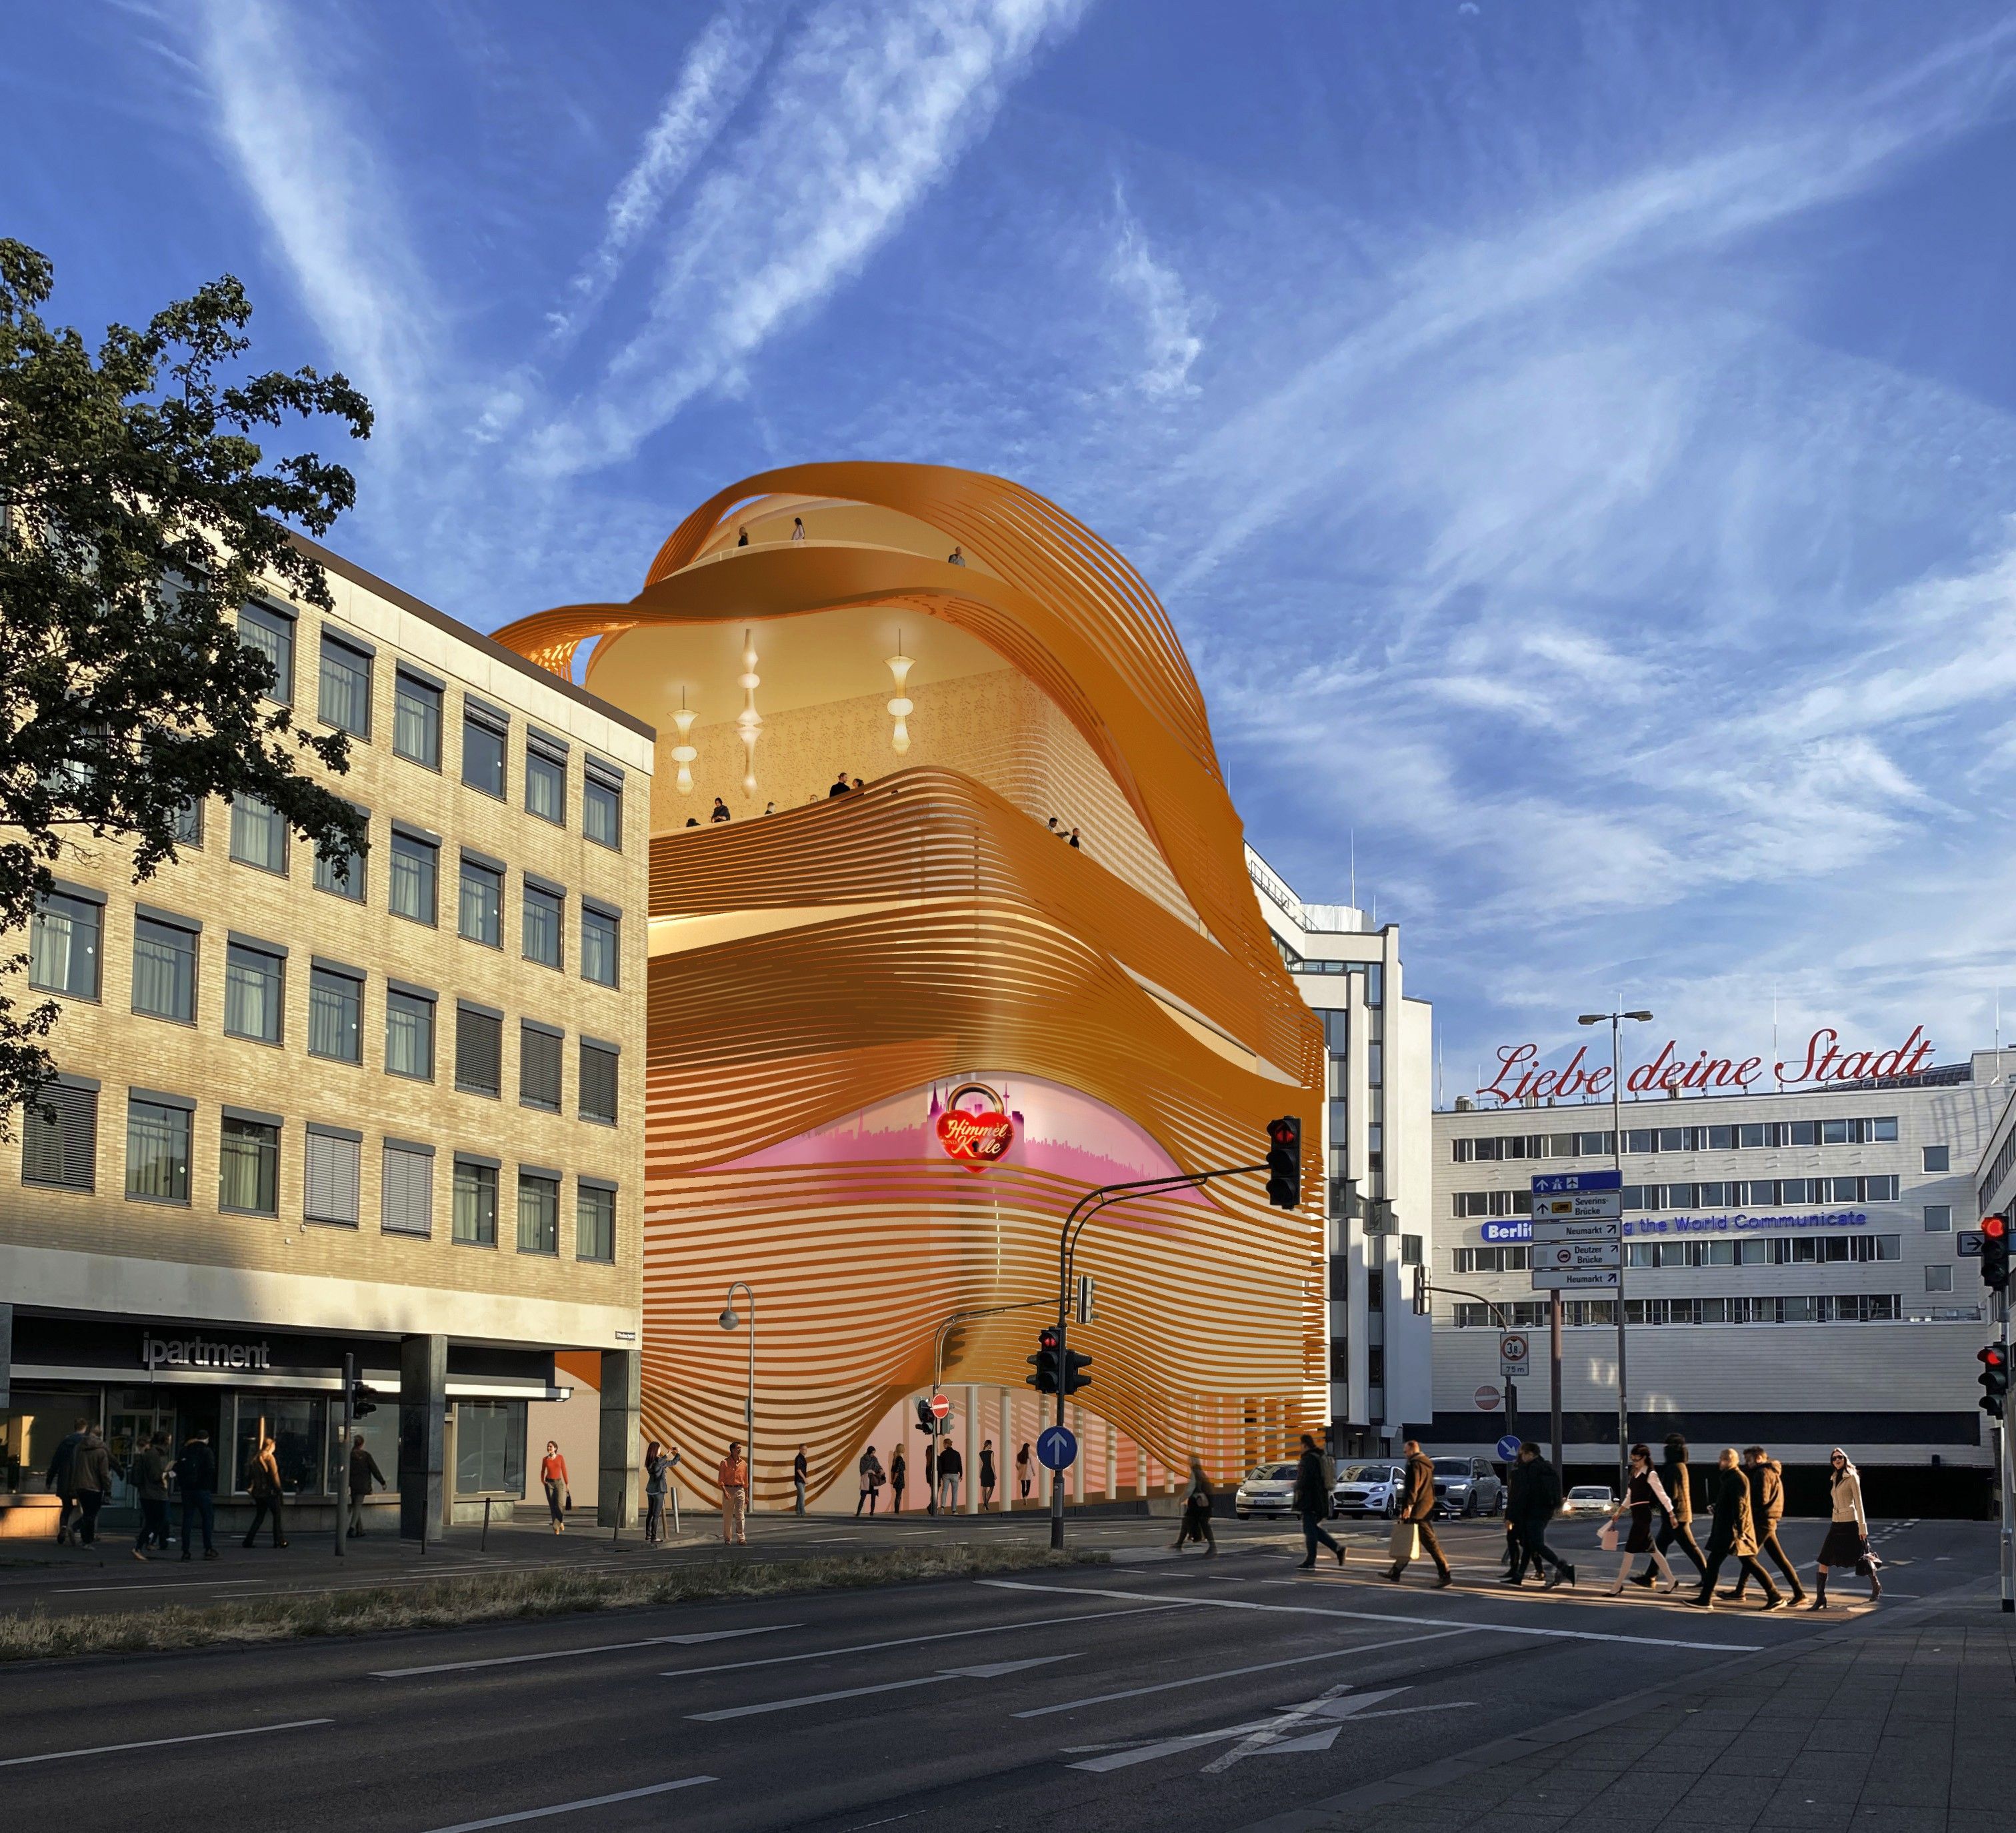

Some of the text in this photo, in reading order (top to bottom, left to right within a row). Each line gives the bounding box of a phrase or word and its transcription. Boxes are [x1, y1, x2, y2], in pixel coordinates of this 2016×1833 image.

[1475, 1024, 1936, 1104] Liebe deine Stadt
[945, 1119, 1009, 1139] Himmel
[1575, 1207, 1601, 1216] Brücke
[1639, 1218, 1667, 1232] the
[1674, 1214, 1727, 1232] World
[1735, 1211, 1867, 1229] Communicate
[1566, 1226, 1603, 1235] Neumarkt
[1567, 1274, 1603, 1283] Heumarkt
[143, 1331, 270, 1370] ipartment
